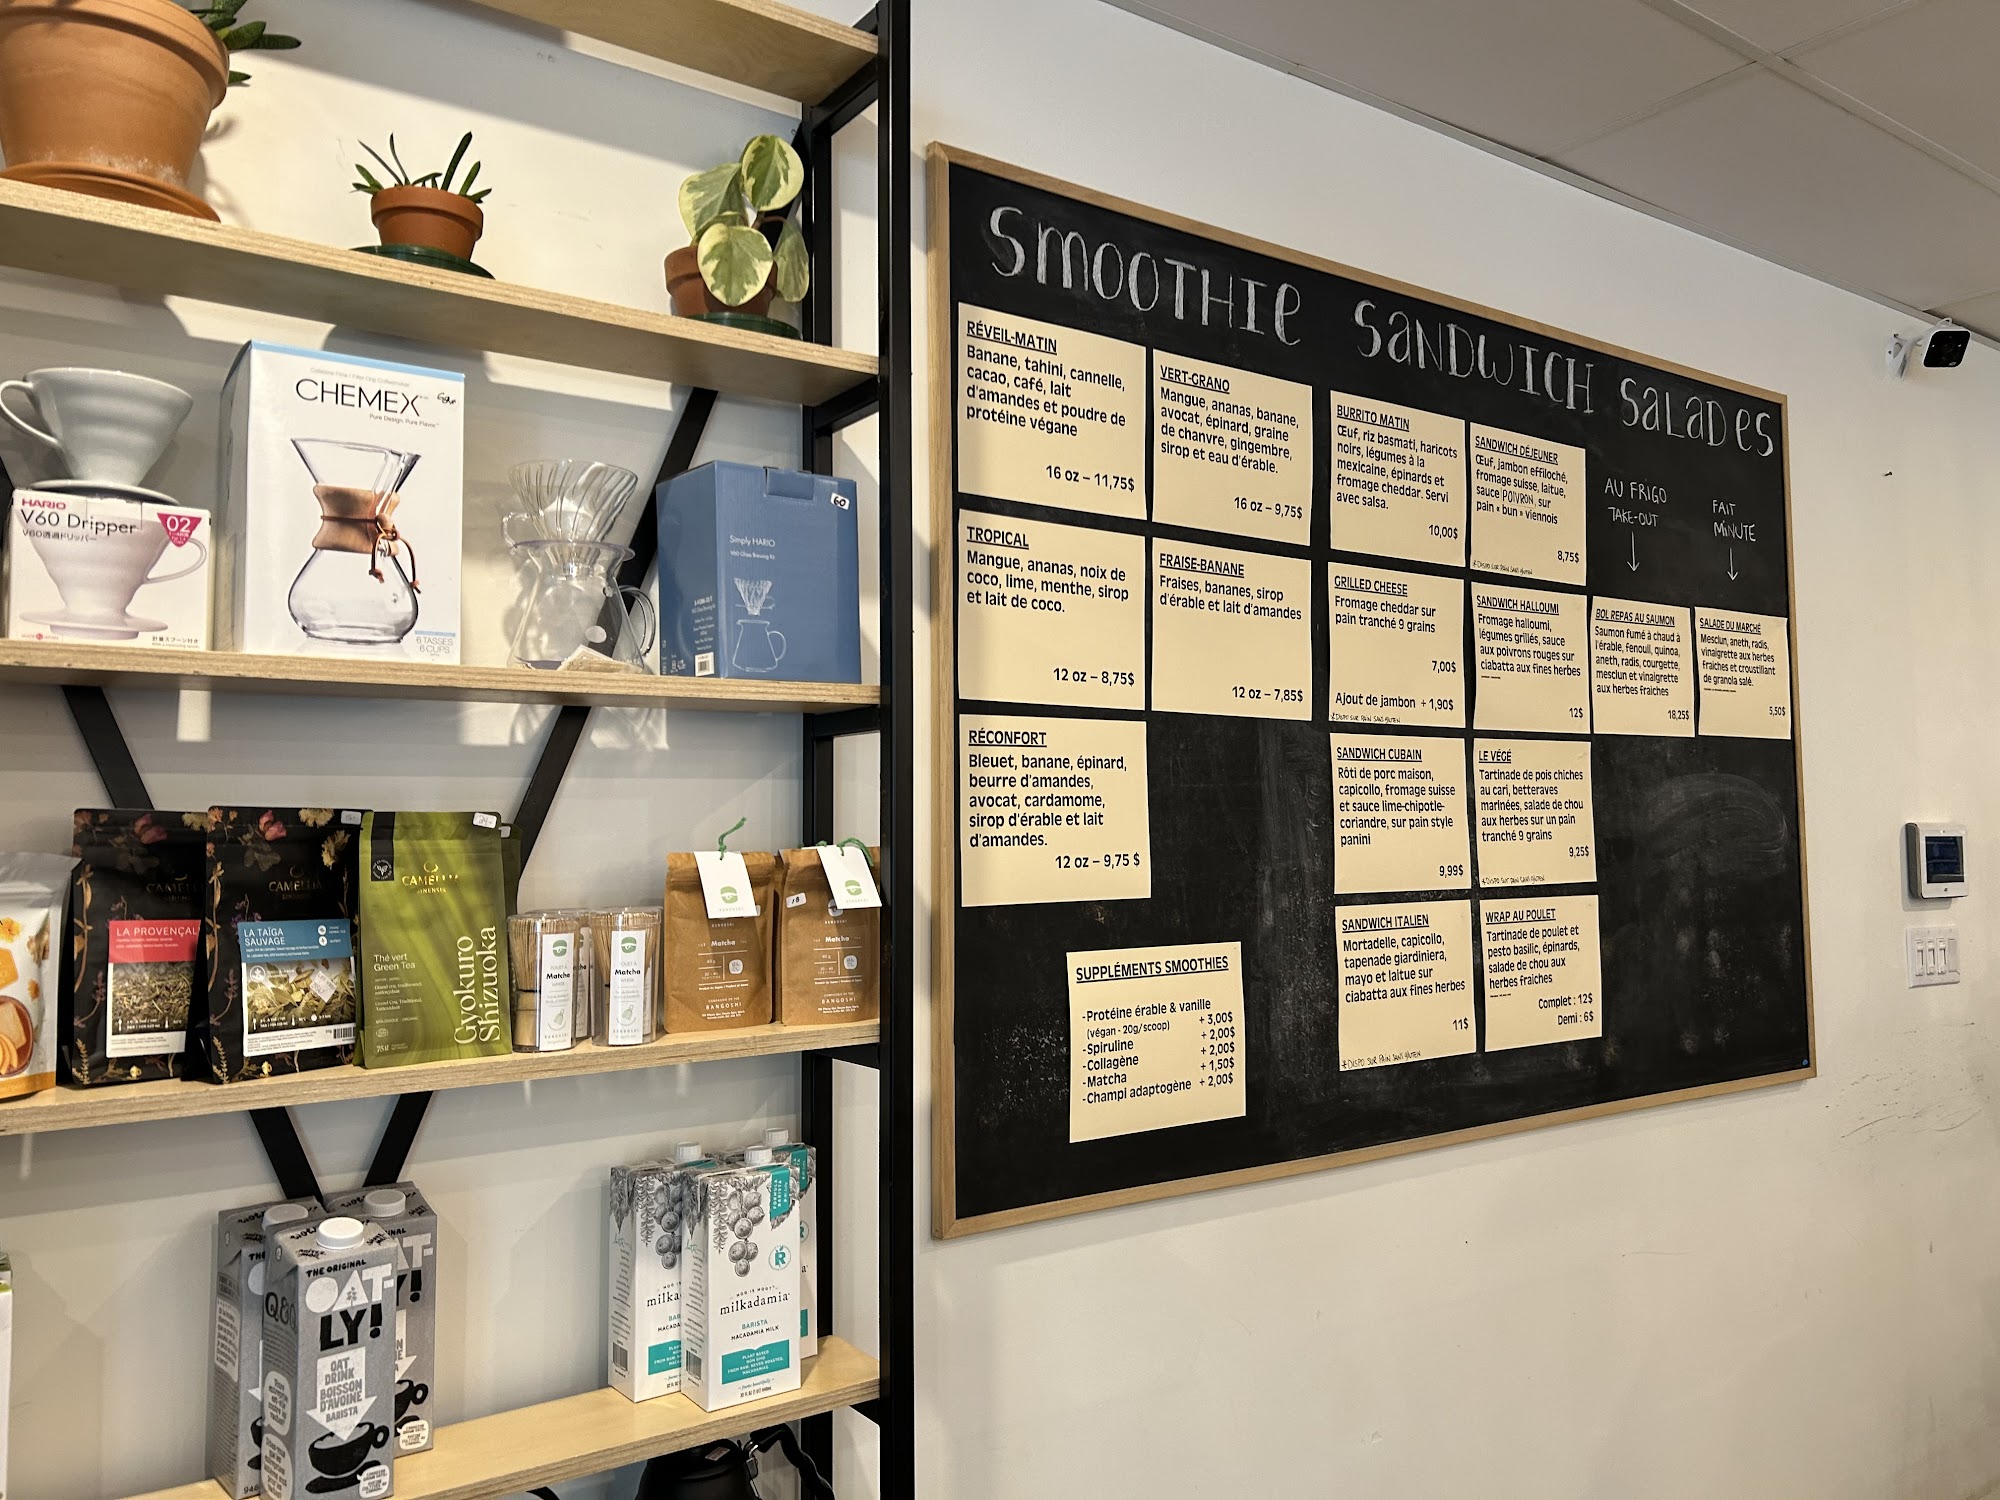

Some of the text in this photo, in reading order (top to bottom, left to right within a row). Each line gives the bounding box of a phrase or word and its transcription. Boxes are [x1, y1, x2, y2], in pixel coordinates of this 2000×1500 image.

[967, 320, 1057, 353] RÉVEIL-MATIN
[967, 344, 1125, 392] Banane, tahini, cannelle,
[1160, 364, 1230, 392] VERT-GRANO
[295, 378, 420, 417] CHEMEX
[1160, 386, 1298, 429] Mangue, ananas, banane,
[1337, 404, 1410, 430] BURRITO MATIN
[1475, 435, 1558, 463] SANDWICH DÉJEUNER
[1604, 477, 1667, 505] AU FRIGO
[21, 498, 67, 510] HARIO
[1712, 499, 1736, 516] FAIT
[20, 509, 137, 536] V60 Dripper
[166, 516, 190, 533] 02
[1607, 506, 1659, 527] TAKE-OUT
[966, 525, 1029, 547] TROPICAL
[1428, 524, 1458, 540] 10,00$
[1713, 519, 1757, 542] MINUTE
[730, 534, 776, 548] Simply HARIO
[1159, 552, 1244, 576] FRAISE-BANANE
[1557, 550, 1579, 564] 8,75$
[1160, 574, 1284, 603] Fraises, bananes, sirop
[1334, 575, 1408, 595] GRILLED CHEESE
[1476, 594, 1559, 613] SANDWICH HALLOUMI
[1478, 613, 1552, 633] Fromage halloumi,
[1595, 608, 1675, 626] BOL REPAS AU SAUMON
[1699, 617, 1761, 633] SALADE DU MARCHÉ
[423, 636, 454, 646] TASSES
[426, 645, 450, 654] CUPS
[1432, 660, 1456, 674] 7,00$
[1569, 707, 1583, 719] 12$
[1668, 709, 1690, 721] 18,25$
[1769, 706, 1786, 717] 5,50$
[968, 727, 1047, 745] RÉCONFORT
[1336, 746, 1422, 760] SANDWICH CUBAIN
[1479, 748, 1512, 761] LE VÉGÉ
[969, 753, 1126, 772] Bleuet, banane, épinard,
[1340, 835, 1371, 848] panini
[1568, 845, 1589, 858] 9,25$
[1439, 864, 1464, 878] 9,99$
[1342, 914, 1429, 931] SANDWICH ITALIEN
[1485, 908, 1556, 923] WRAP AU POULET
[116, 926, 200, 937] LA PROVENÇAL
[244, 927, 284, 937] LA TAÏGA
[244, 936, 286, 947] SAUVAGE
[711, 939, 736, 947] Matcha
[1343, 932, 1445, 952] Mortadelle, capicollo,
[374, 953, 408, 962] Thé vert
[374, 962, 416, 972] Green Tea
[1076, 955, 1228, 980] SUPPLÉMENTS SMOOTHIES
[452, 936, 482, 1044] Gyokuro
[476, 925, 500, 1042] Shizuoka
[706, 1002, 742, 1010] BANGOSHI
[1452, 1017, 1469, 1030] 11$
[1209, 1025, 1235, 1041] 2,00$
[1082, 1039, 1134, 1056] -Spiruline
[1200, 1041, 1235, 1056] + 2,00$
[1082, 1055, 1139, 1071] -Collagène
[306, 1259, 366, 1278] THE ORIGINAL
[305, 1263, 394, 1313] OAT-
[647, 1291, 681, 1307] milka
[720, 1292, 789, 1315] milkadamia
[320, 1302, 383, 1352] LY!
[731, 1325, 779, 1341] MACADAMIA MILK
[742, 1319, 768, 1330] BARISTA
[330, 1356, 350, 1372] OAT
[325, 1368, 354, 1386] DRINK
[320, 1378, 362, 1400] BOISSON
[320, 1390, 362, 1413] D'AVOINE
[326, 1406, 358, 1423] BARISTA
